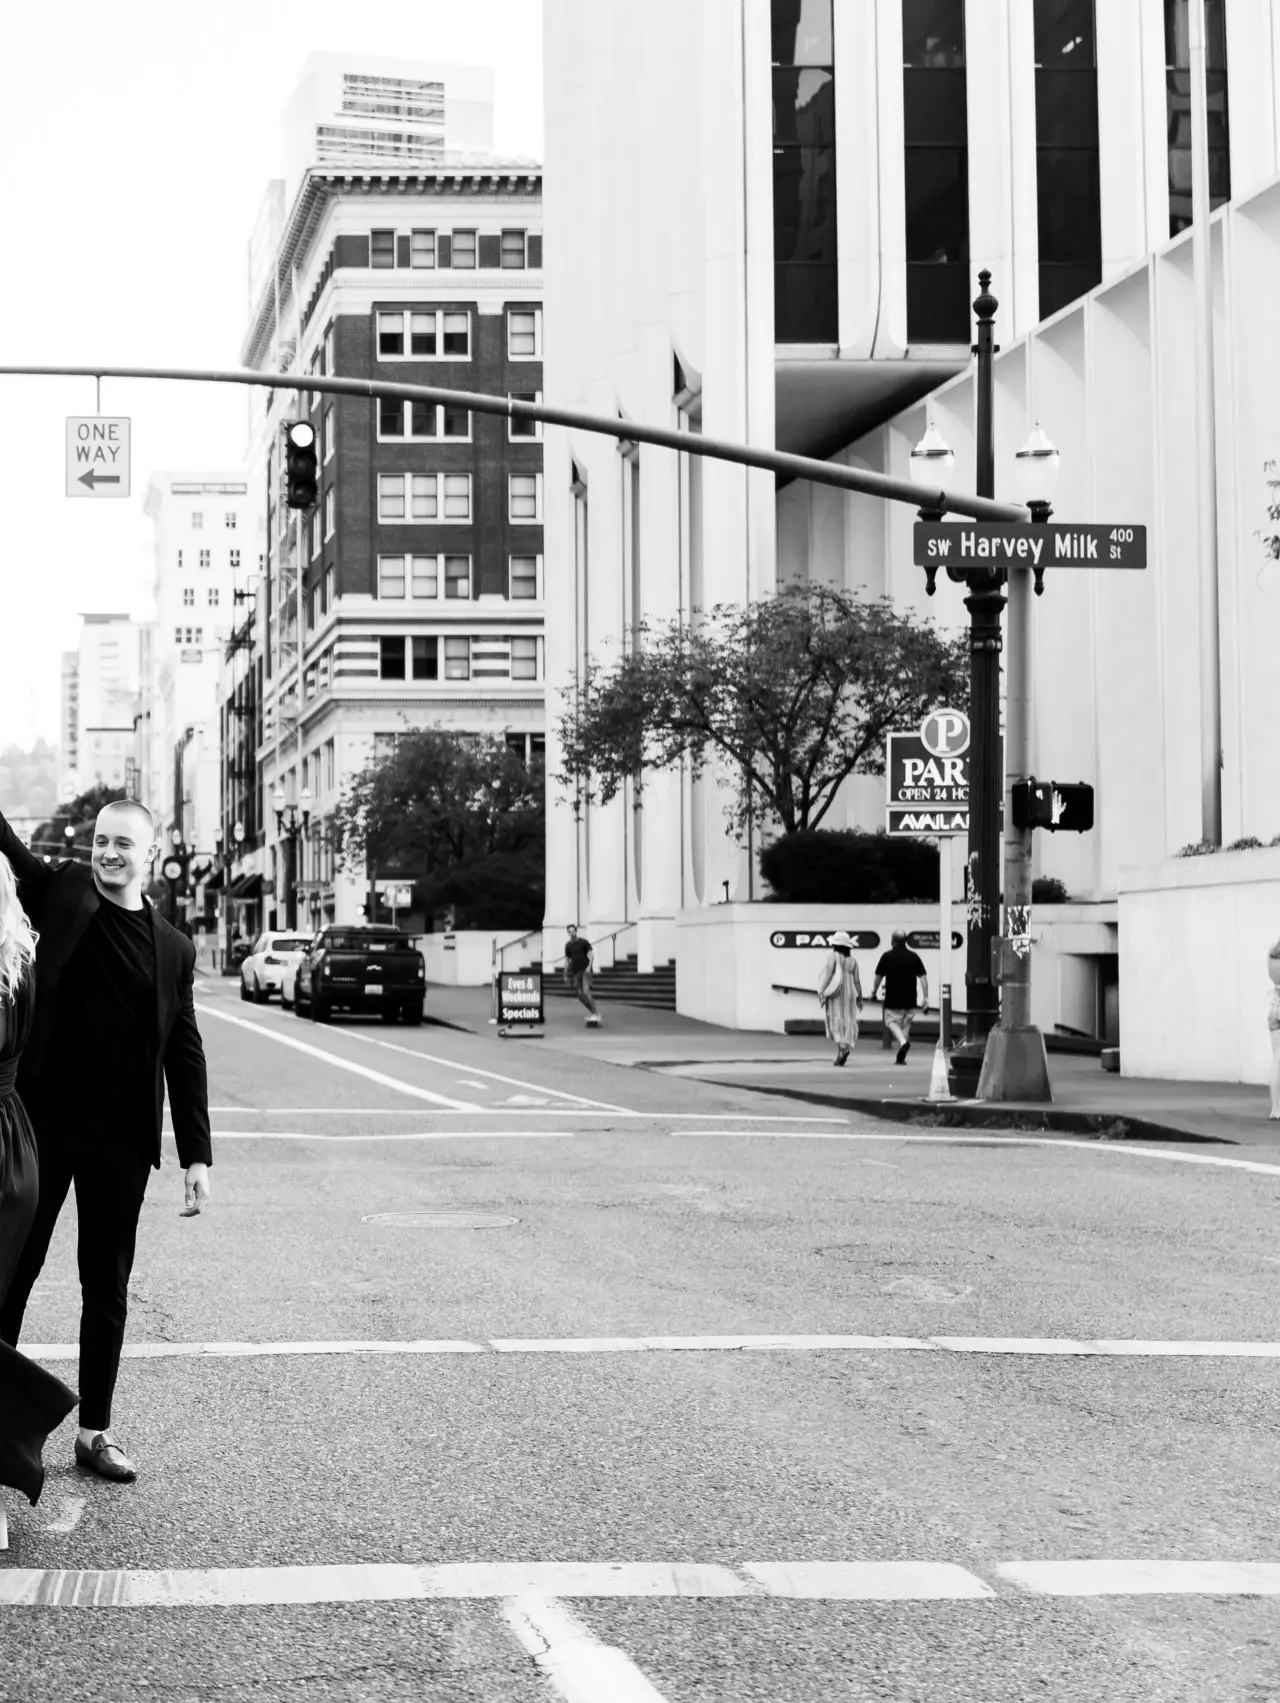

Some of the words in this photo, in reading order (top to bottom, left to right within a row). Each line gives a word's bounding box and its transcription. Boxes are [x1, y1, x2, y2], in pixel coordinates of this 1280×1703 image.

[78, 423, 119, 441] ONE
[76, 445, 120, 463] WAY
[1109, 528, 1134, 543] 400
[927, 538, 951, 557] SW
[960, 531, 1044, 565] Harvey
[1054, 532, 1098, 559] Milk
[1109, 545, 1122, 560] St
[933, 714, 964, 752] P
[902, 757, 970, 787] PAR
[898, 787, 931, 801] OPEN
[933, 788, 948, 801] 24
[898, 812, 970, 830] AVAILA
[796, 934, 860, 947] PAK
[502, 1007, 540, 1020] Specials
